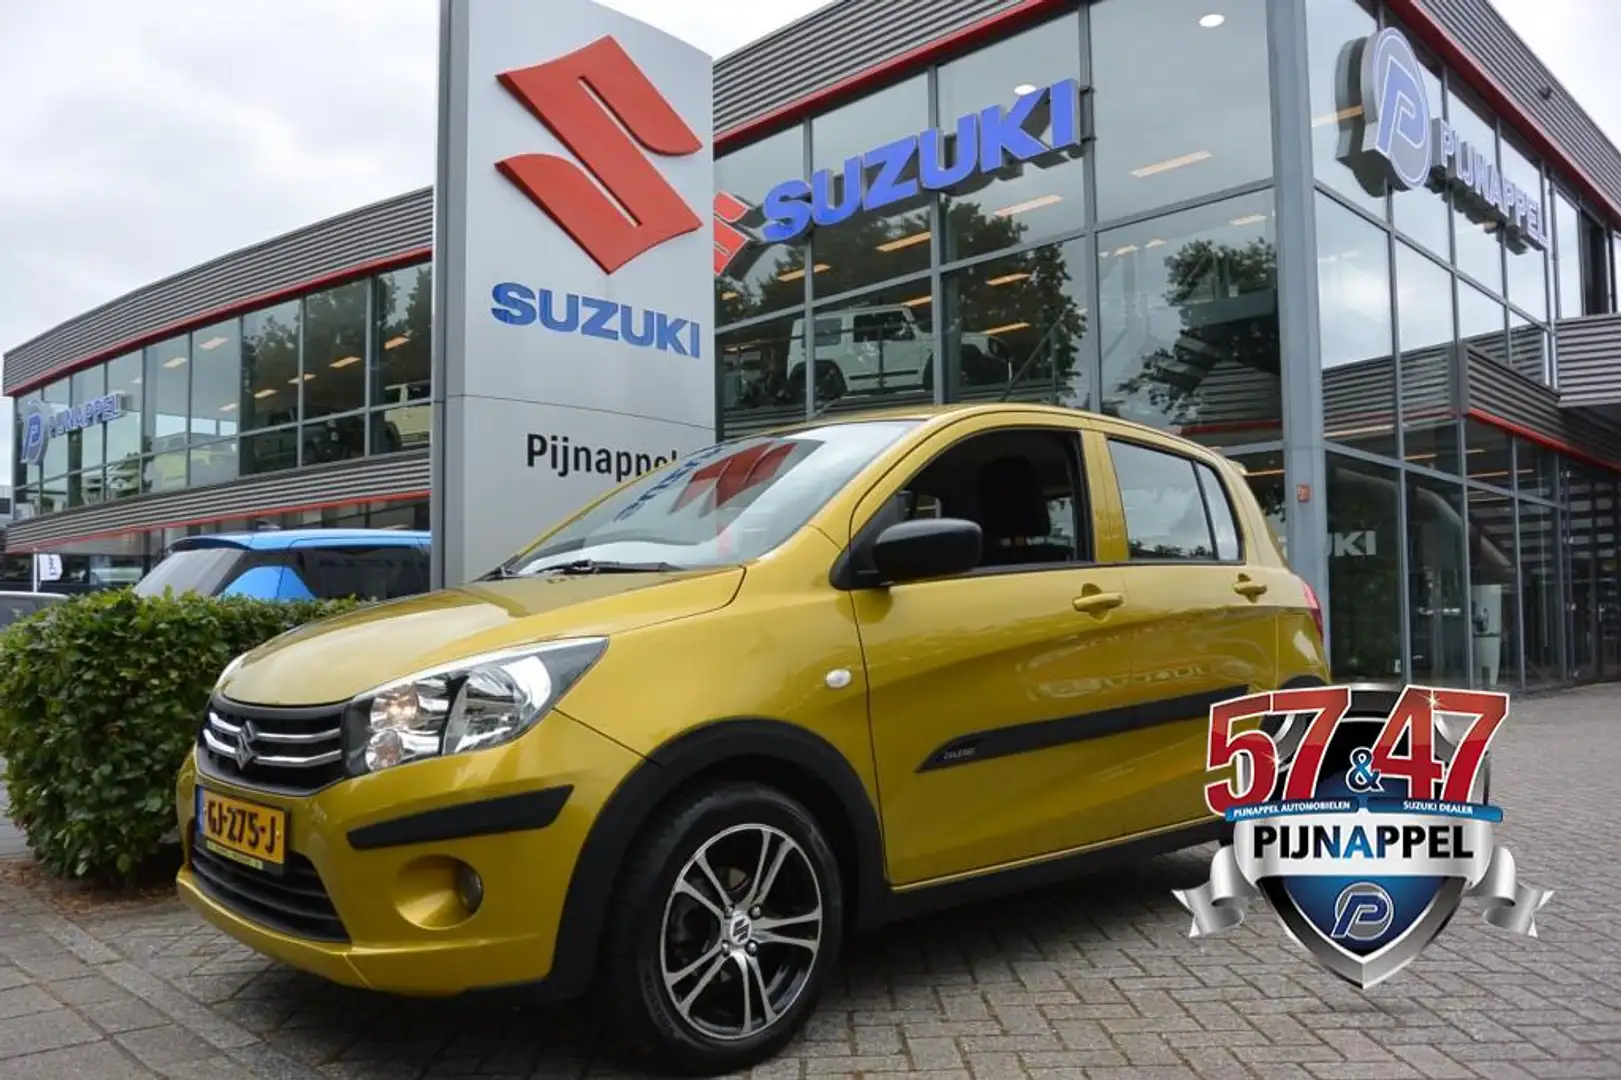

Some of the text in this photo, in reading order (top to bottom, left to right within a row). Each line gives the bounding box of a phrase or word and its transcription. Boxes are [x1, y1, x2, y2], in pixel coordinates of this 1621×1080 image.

[761, 78, 1077, 244] SUZUKI
[490, 281, 700, 359] SUZUKI
[527, 433, 677, 483] Pijnapp
